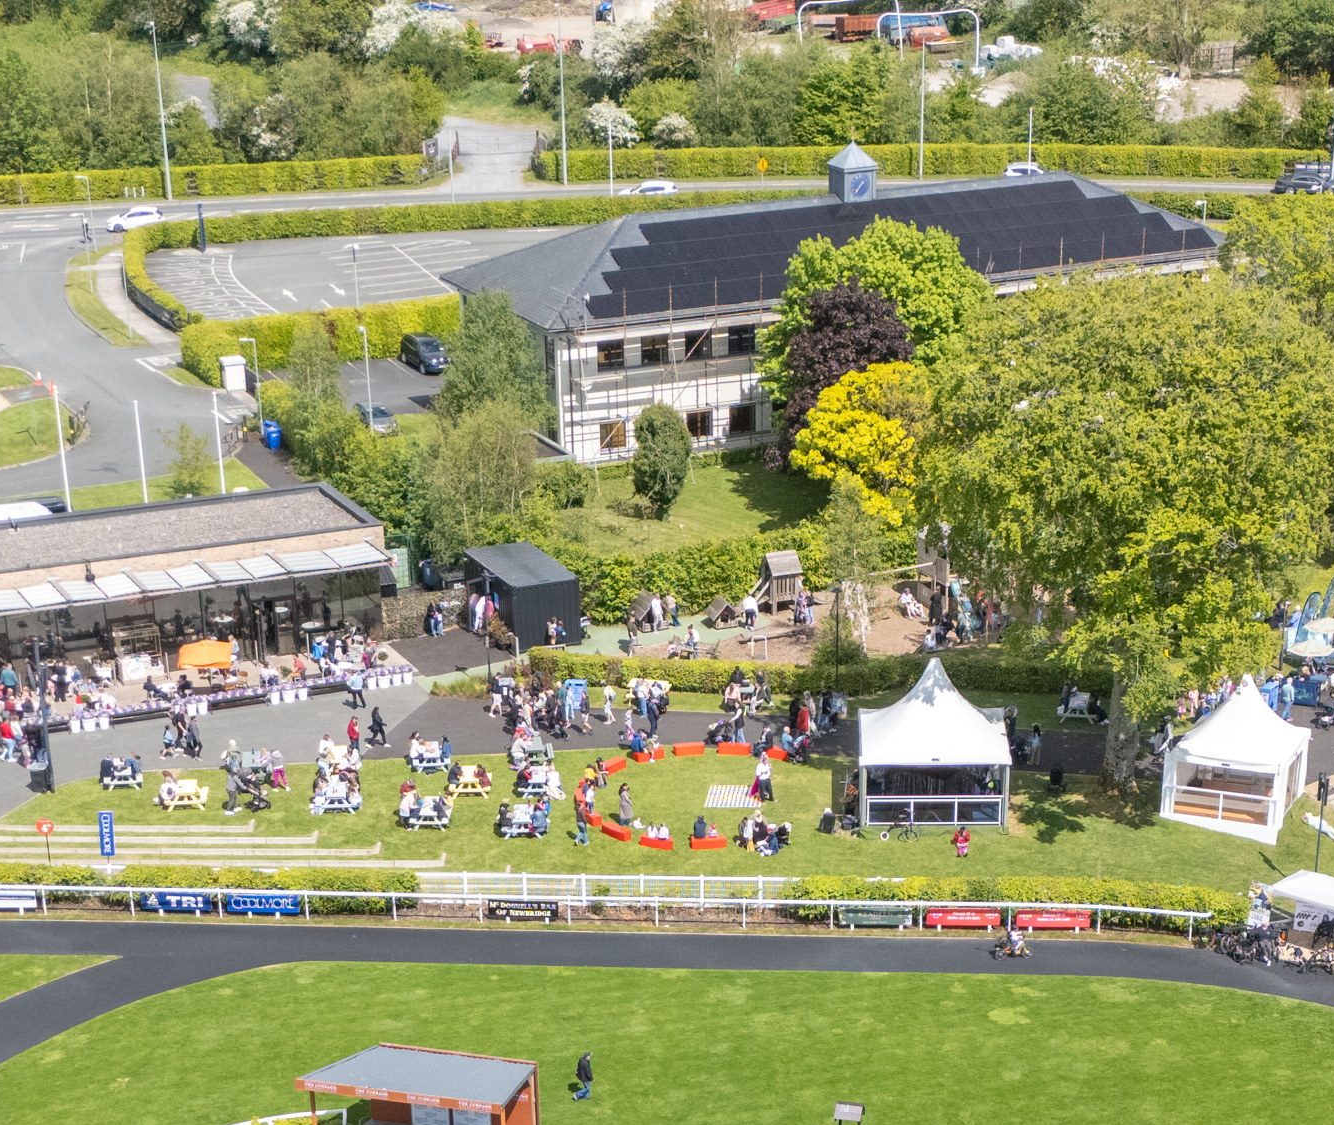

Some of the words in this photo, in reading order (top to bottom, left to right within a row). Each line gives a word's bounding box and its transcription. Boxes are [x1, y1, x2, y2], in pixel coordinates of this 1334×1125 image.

[100, 814, 112, 854] COOLMORE
[166, 895, 204, 908] TRI
[231, 897, 296, 909] COOLMORE
